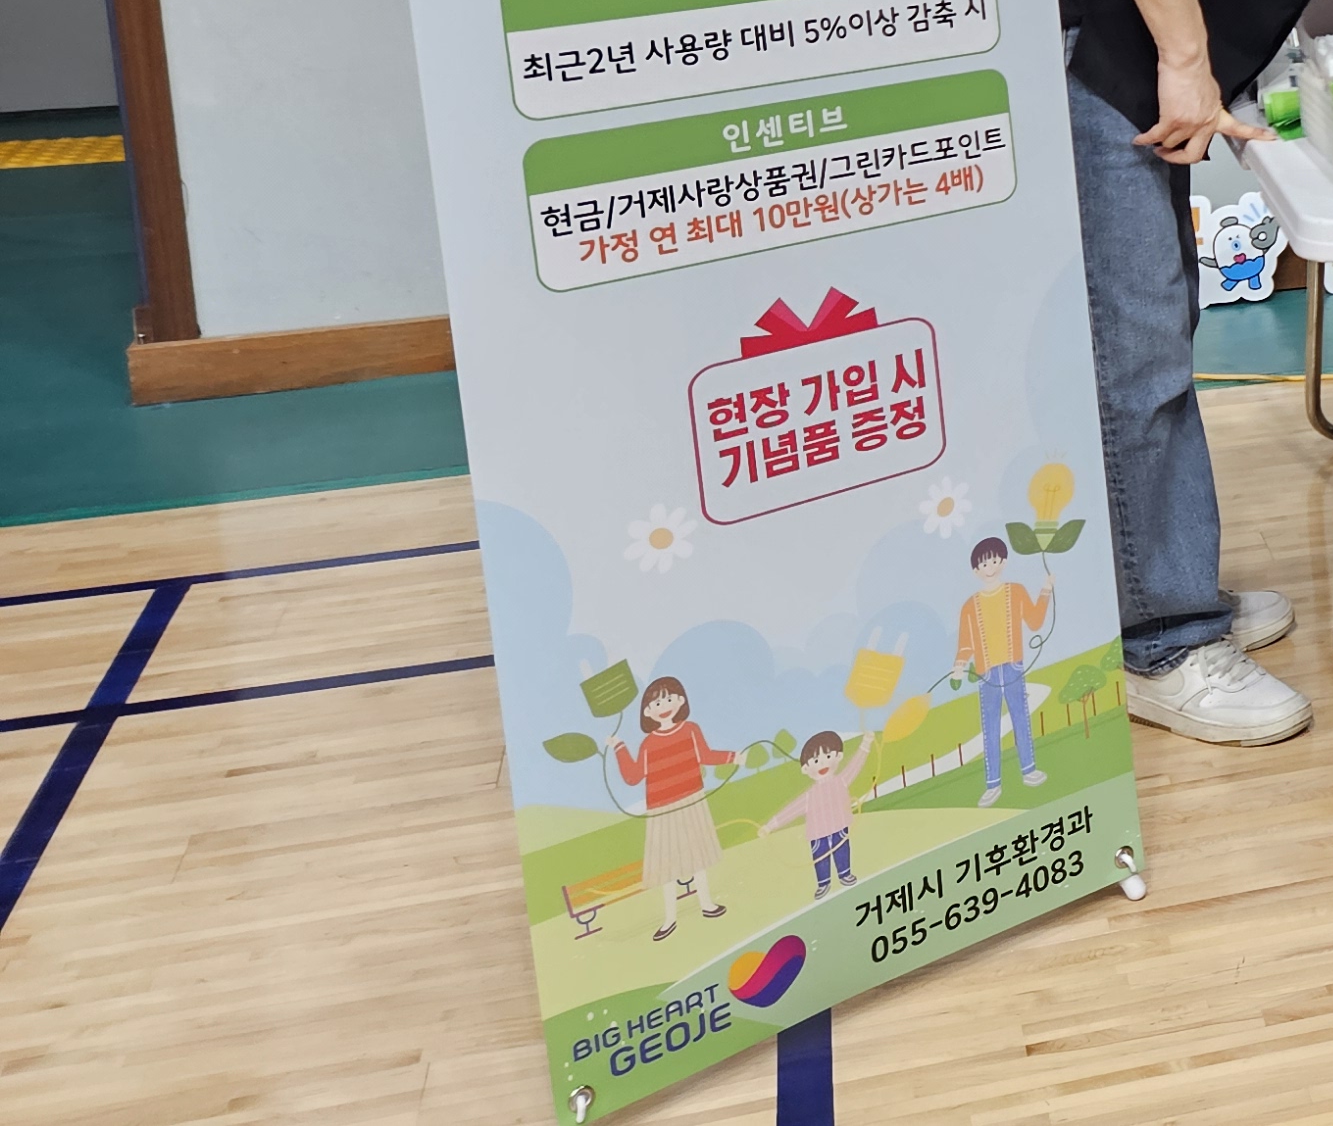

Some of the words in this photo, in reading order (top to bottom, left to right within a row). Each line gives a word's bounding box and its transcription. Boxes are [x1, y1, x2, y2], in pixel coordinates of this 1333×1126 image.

[522, 40, 638, 83] 최근2년
[644, 28, 733, 66] 사용량
[740, 19, 796, 53] 대비
[804, 5, 900, 46] 5%이상
[906, 0, 958, 34] 감축
[722, 105, 849, 154] 인센티브
[540, 127, 1008, 238] 현금/거제사랑상품권/그린카드포인트
[579, 232, 640, 266] 가정
[649, 225, 679, 256] 연
[686, 210, 744, 247] 최대
[752, 177, 929, 232] 10만원(상가는
[935, 163, 986, 197] 4배)
[707, 382, 791, 442] 현장
[801, 359, 879, 416] 가입
[890, 347, 927, 394] 시
[718, 420, 842, 489] 기념품
[850, 395, 928, 453] 증정
[855, 866, 946, 929] 거제시
[955, 804, 1094, 885] 기후환경과
[870, 850, 1086, 964] 055-639-4083
[572, 1025, 622, 1064] BIG
[625, 983, 720, 1040] HEART
[609, 1002, 733, 1078] GEOJE
